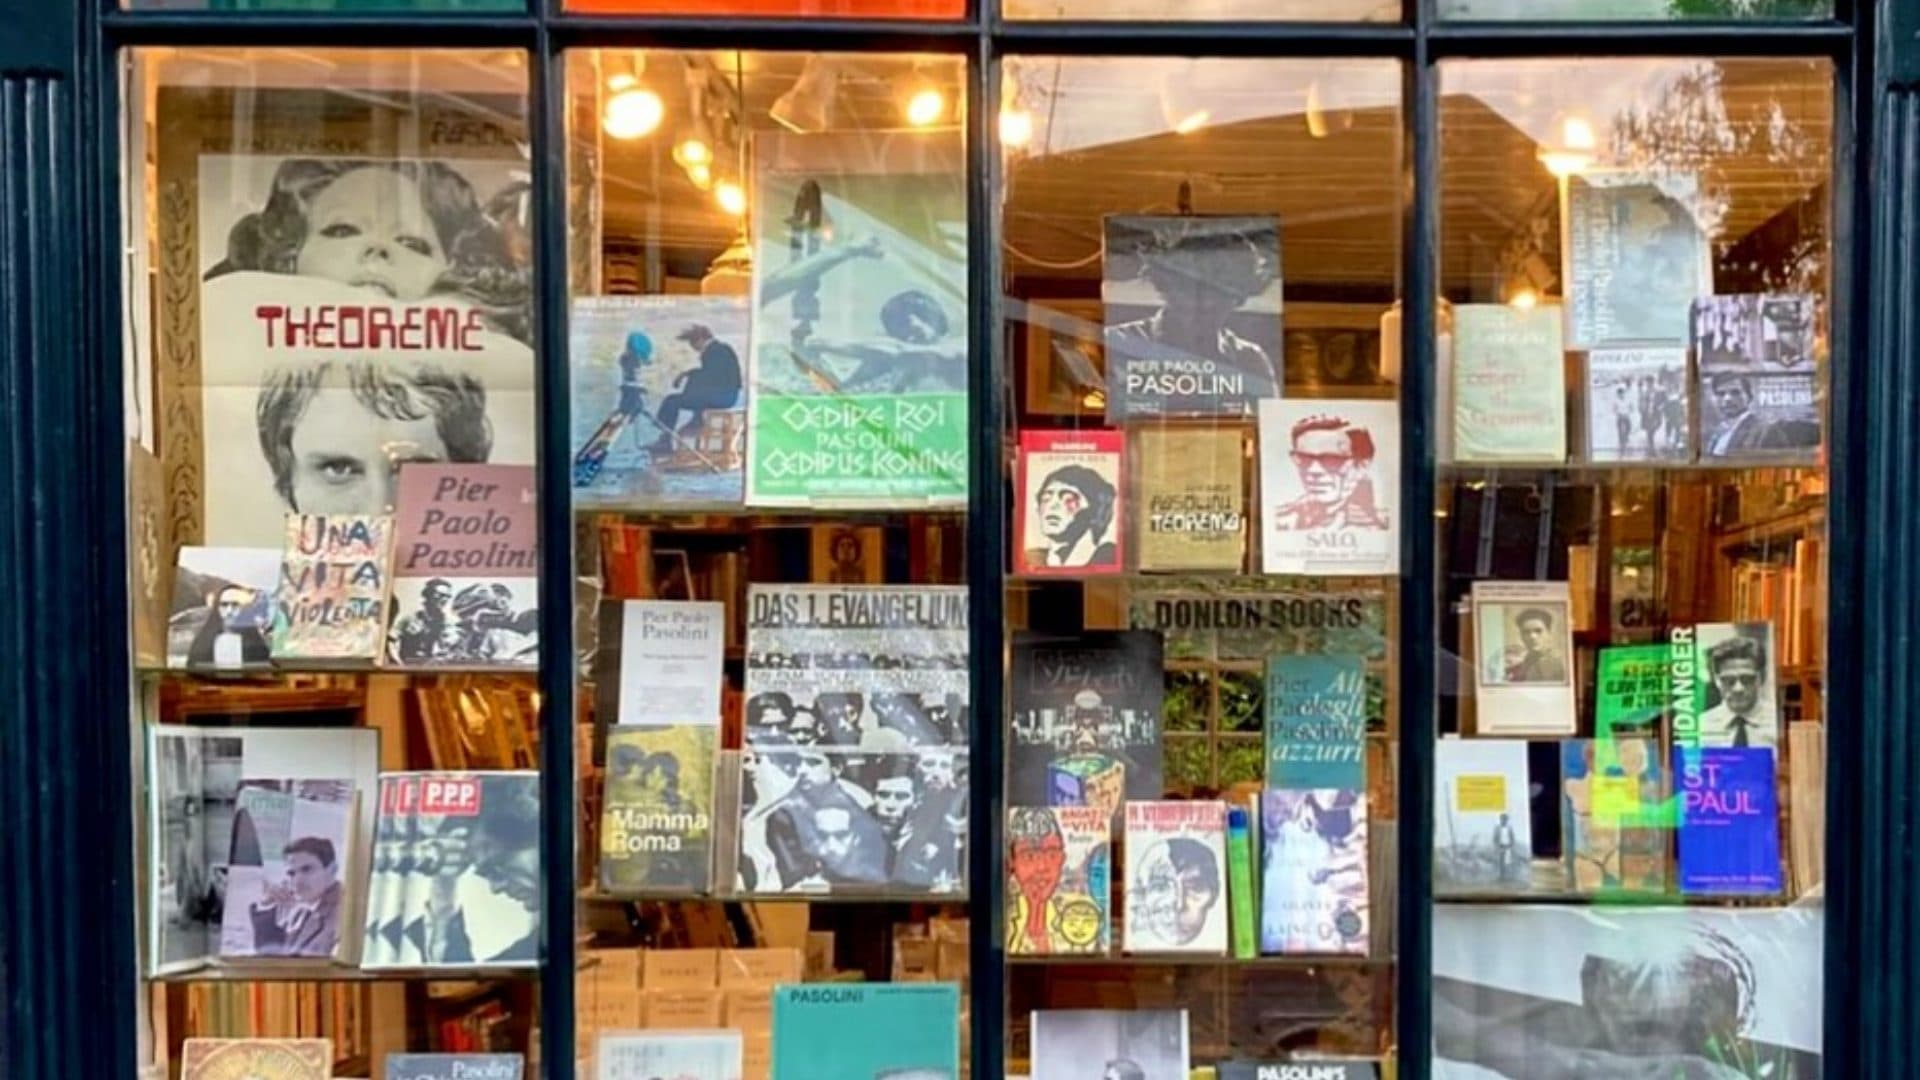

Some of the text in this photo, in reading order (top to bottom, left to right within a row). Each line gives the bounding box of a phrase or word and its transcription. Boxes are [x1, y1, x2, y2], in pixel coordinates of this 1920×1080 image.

[256, 305, 484, 350] THEOREME
[1126, 360, 1217, 373] PIER PAOLO
[1126, 374, 1243, 395] PASOLINI
[896, 400, 945, 432] ROI
[816, 431, 914, 449] PASOLINI
[434, 476, 499, 502] Pier
[420, 508, 511, 535] Paolo
[1150, 512, 1241, 533] TEOREMA
[299, 514, 374, 555] UNA
[406, 541, 538, 569] Pasolini
[281, 561, 380, 592] VITA
[754, 593, 798, 626] DAS
[1155, 598, 1363, 630] DONLON BOOKS
[642, 624, 709, 640] Pasolini
[1272, 744, 1362, 763] azzurri
[1683, 763, 1721, 788] ST
[1683, 790, 1761, 814] PAUL
[613, 809, 709, 830] Mamma
[613, 832, 681, 853] Roma
[791, 989, 865, 1004] PASOLINI
